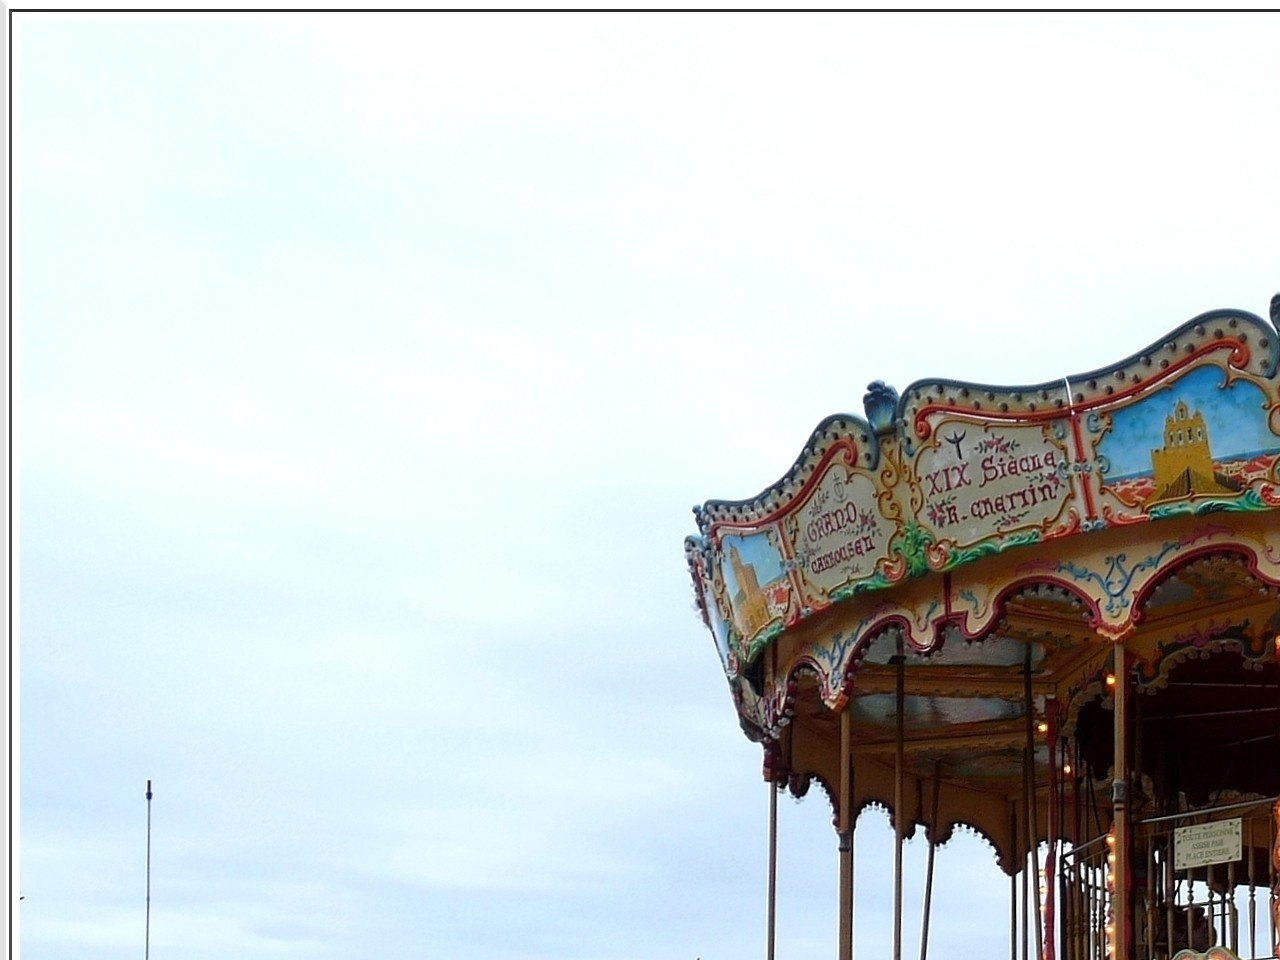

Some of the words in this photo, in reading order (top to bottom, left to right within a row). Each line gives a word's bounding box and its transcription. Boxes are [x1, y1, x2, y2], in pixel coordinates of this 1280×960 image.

[925, 461, 971, 498] XIX
[979, 450, 1058, 488] Siècle
[807, 501, 857, 542] GRAND
[811, 535, 875, 574] CARROUSEL
